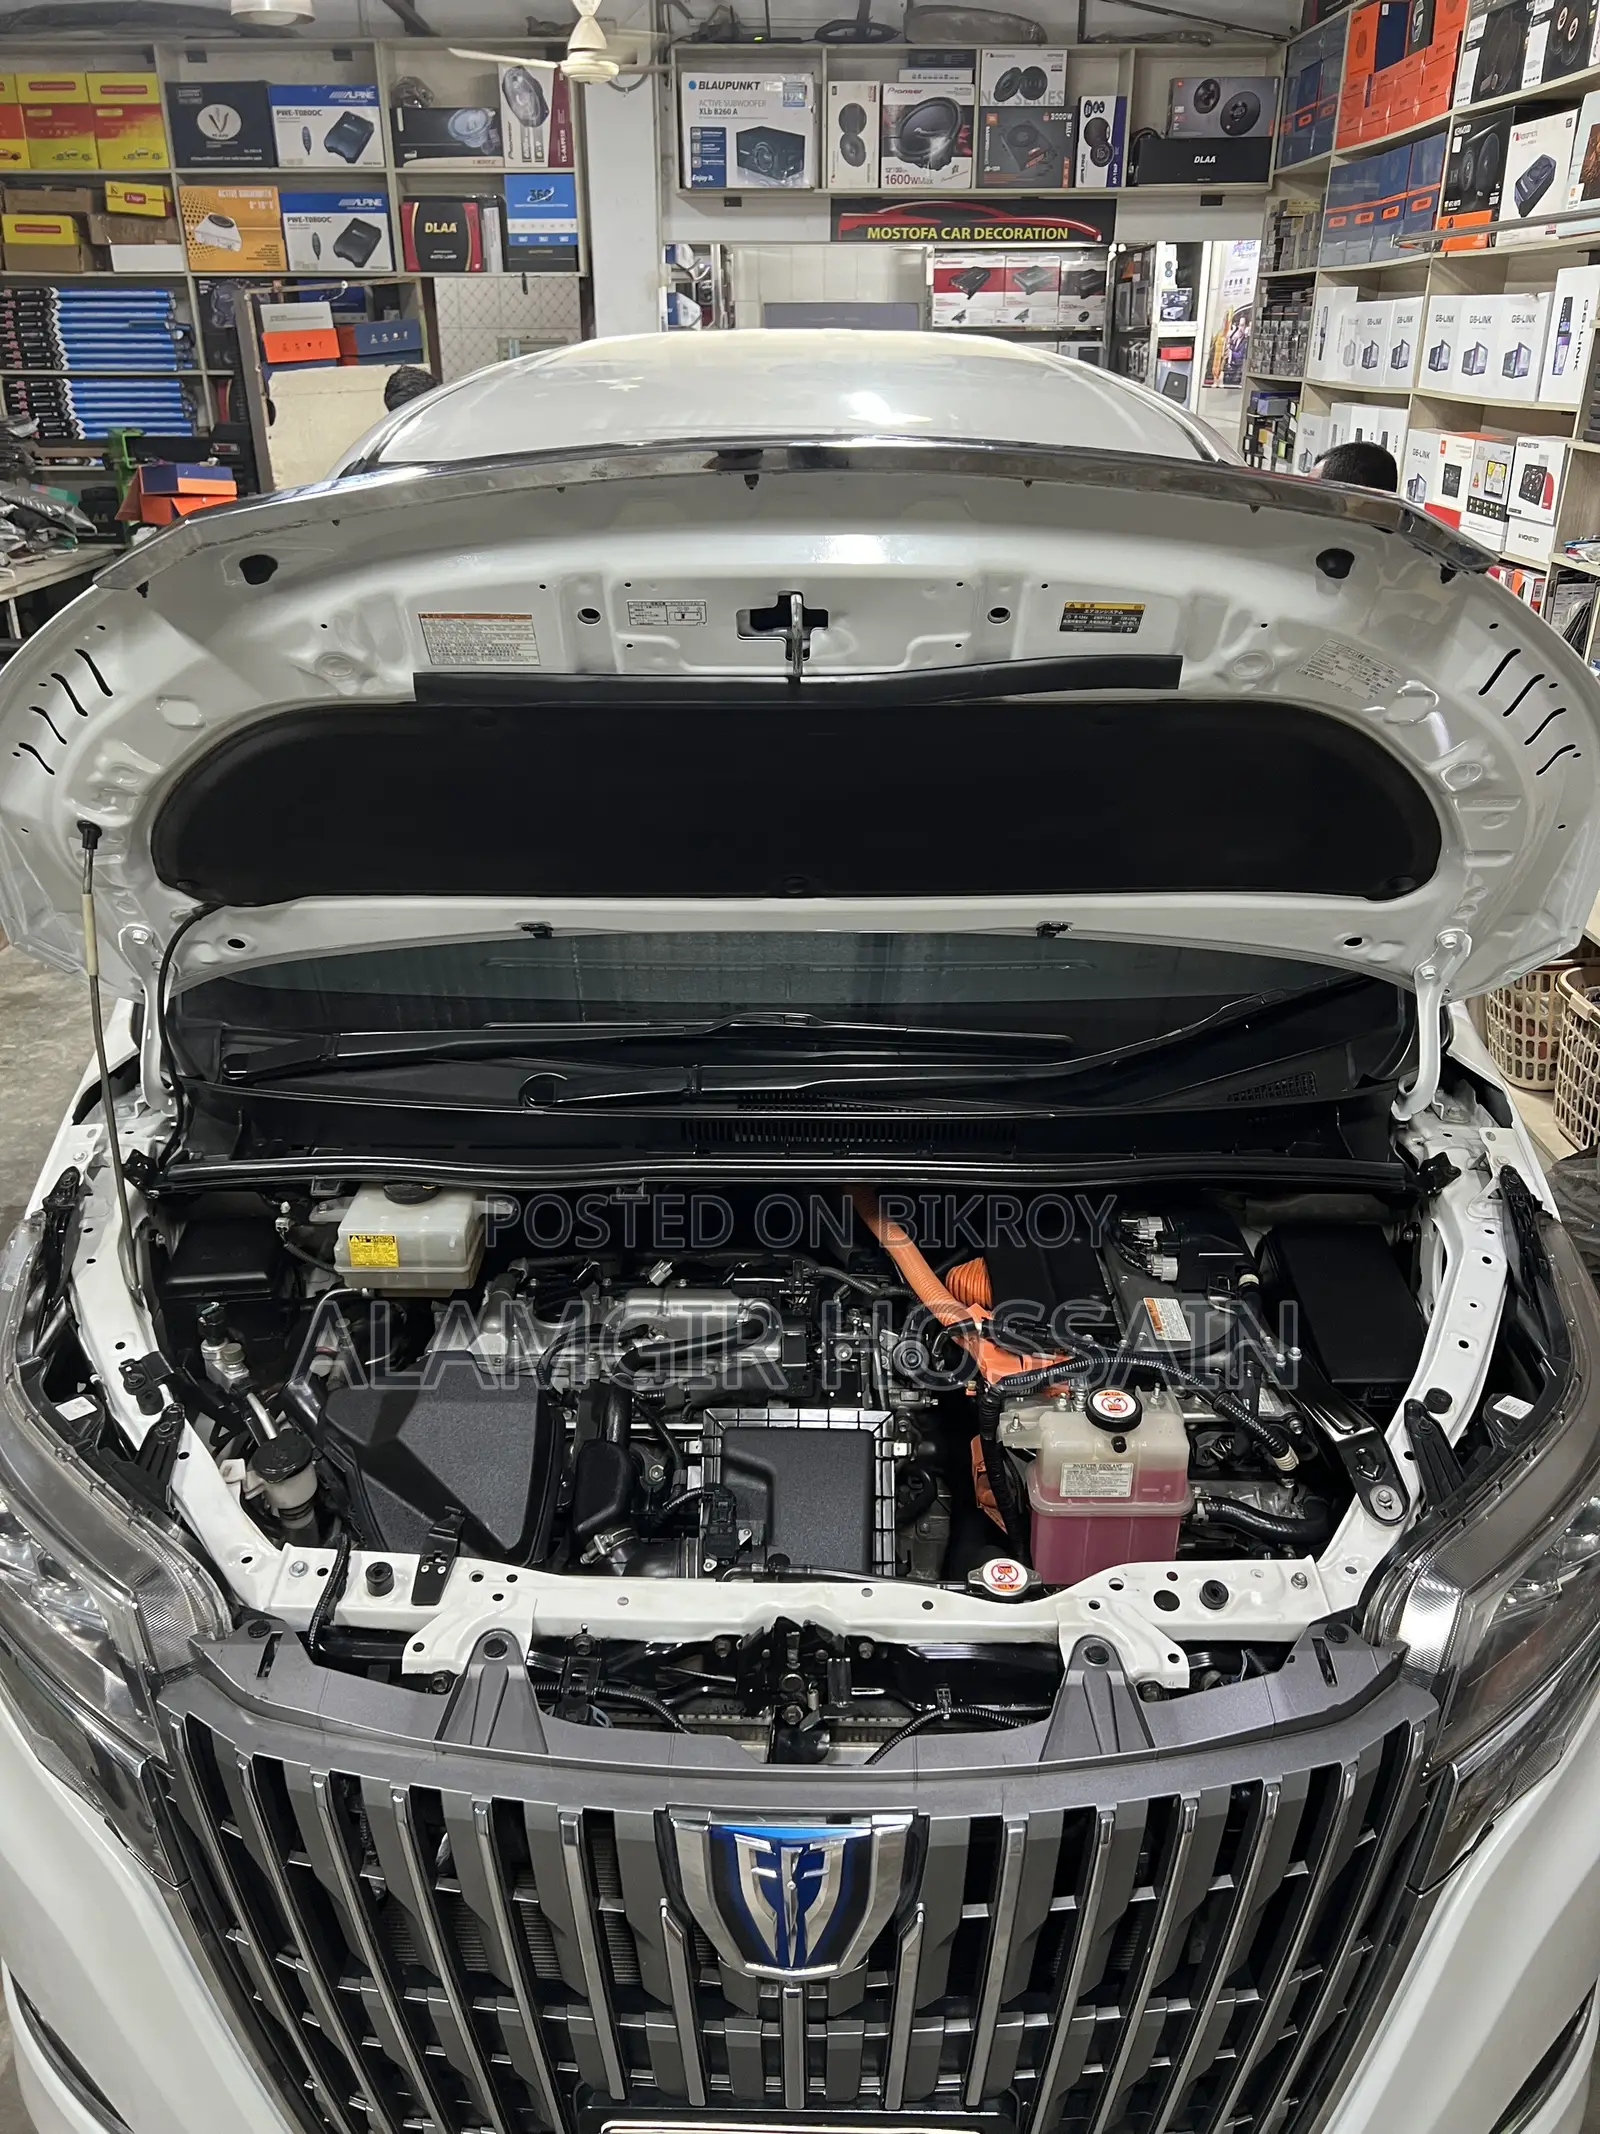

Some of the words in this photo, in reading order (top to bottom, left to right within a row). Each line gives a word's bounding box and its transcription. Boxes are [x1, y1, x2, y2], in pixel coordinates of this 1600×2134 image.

[698, 81, 761, 90] BLAUPUNKT
[1194, 156, 1216, 164] DLAA
[424, 222, 457, 233] DLAA
[867, 227, 938, 240] MOSTOFA
[940, 227, 971, 240] CAR
[974, 227, 1068, 240] DECORATION
